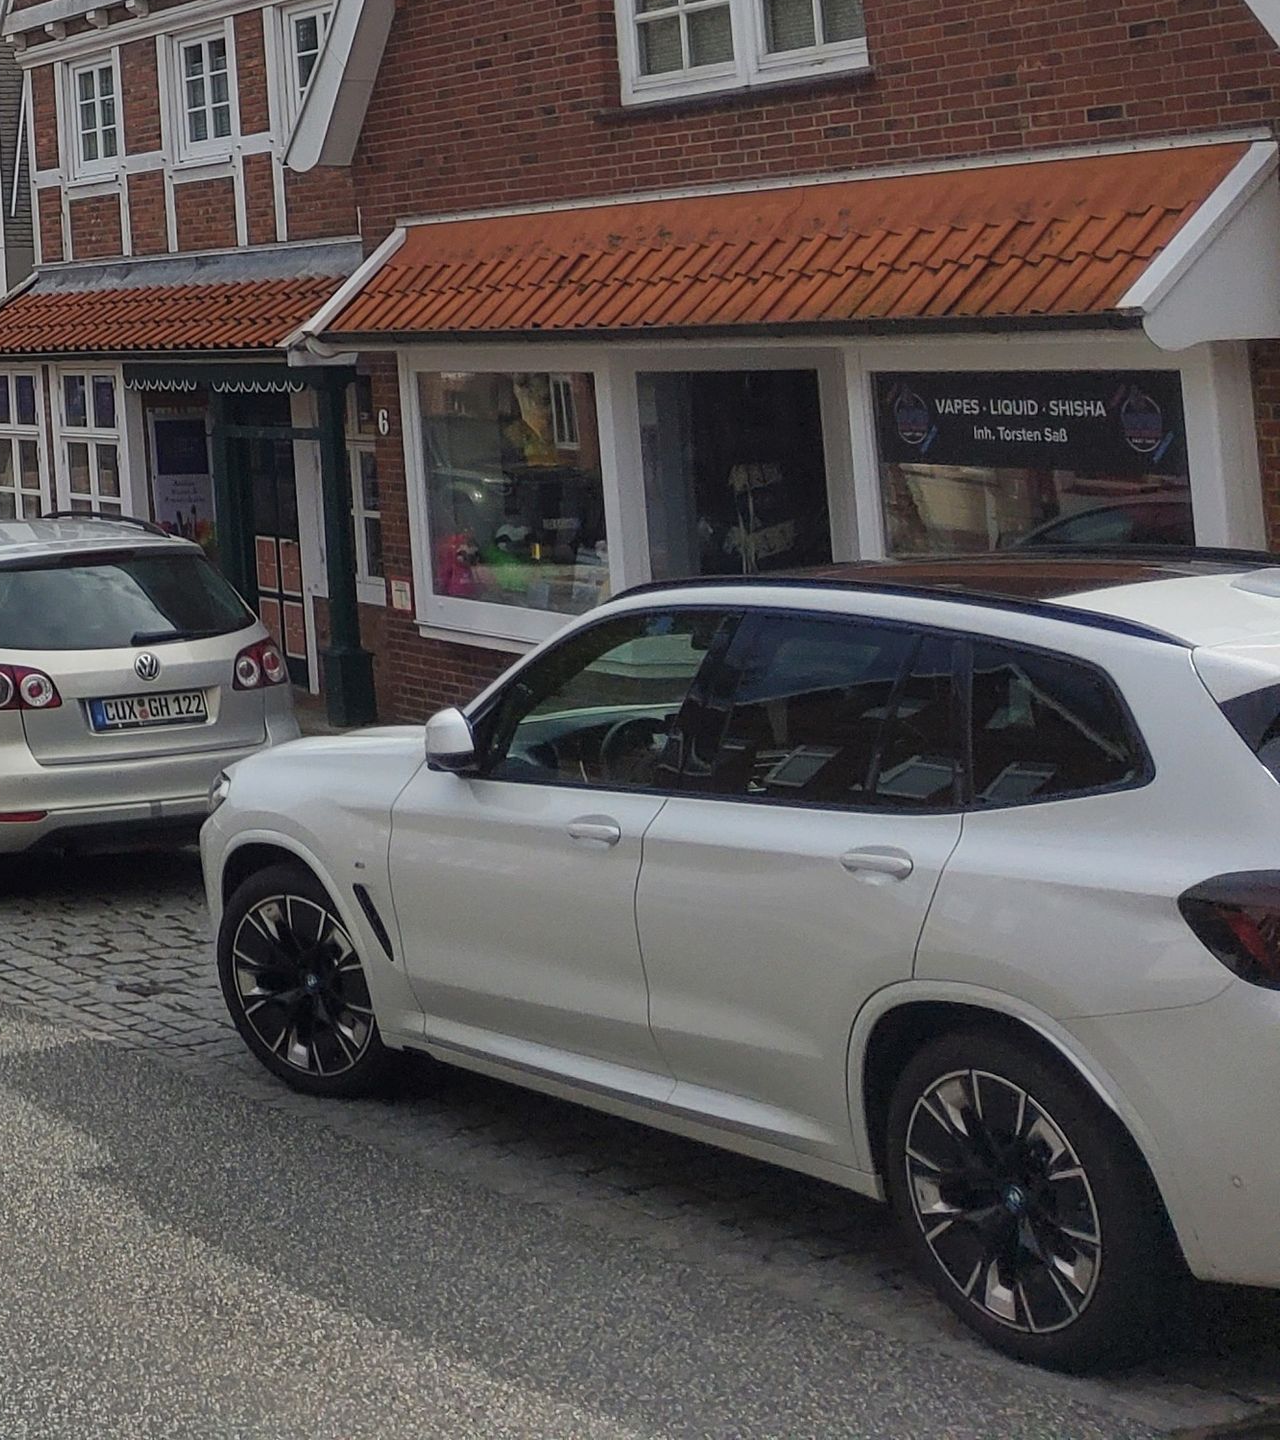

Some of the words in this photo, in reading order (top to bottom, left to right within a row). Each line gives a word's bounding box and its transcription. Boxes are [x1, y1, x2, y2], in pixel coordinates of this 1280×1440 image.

[935, 399, 980, 415] VAPES
[990, 399, 1039, 416] LIQUID
[1049, 400, 1107, 417] SHISHA
[378, 408, 389, 436] 6
[973, 425, 996, 441] Inh.
[997, 426, 1042, 442] Torsten
[1044, 427, 1068, 443] Saß
[104, 700, 138, 721] CUX
[148, 697, 171, 717] GH
[173, 694, 204, 715] 122
